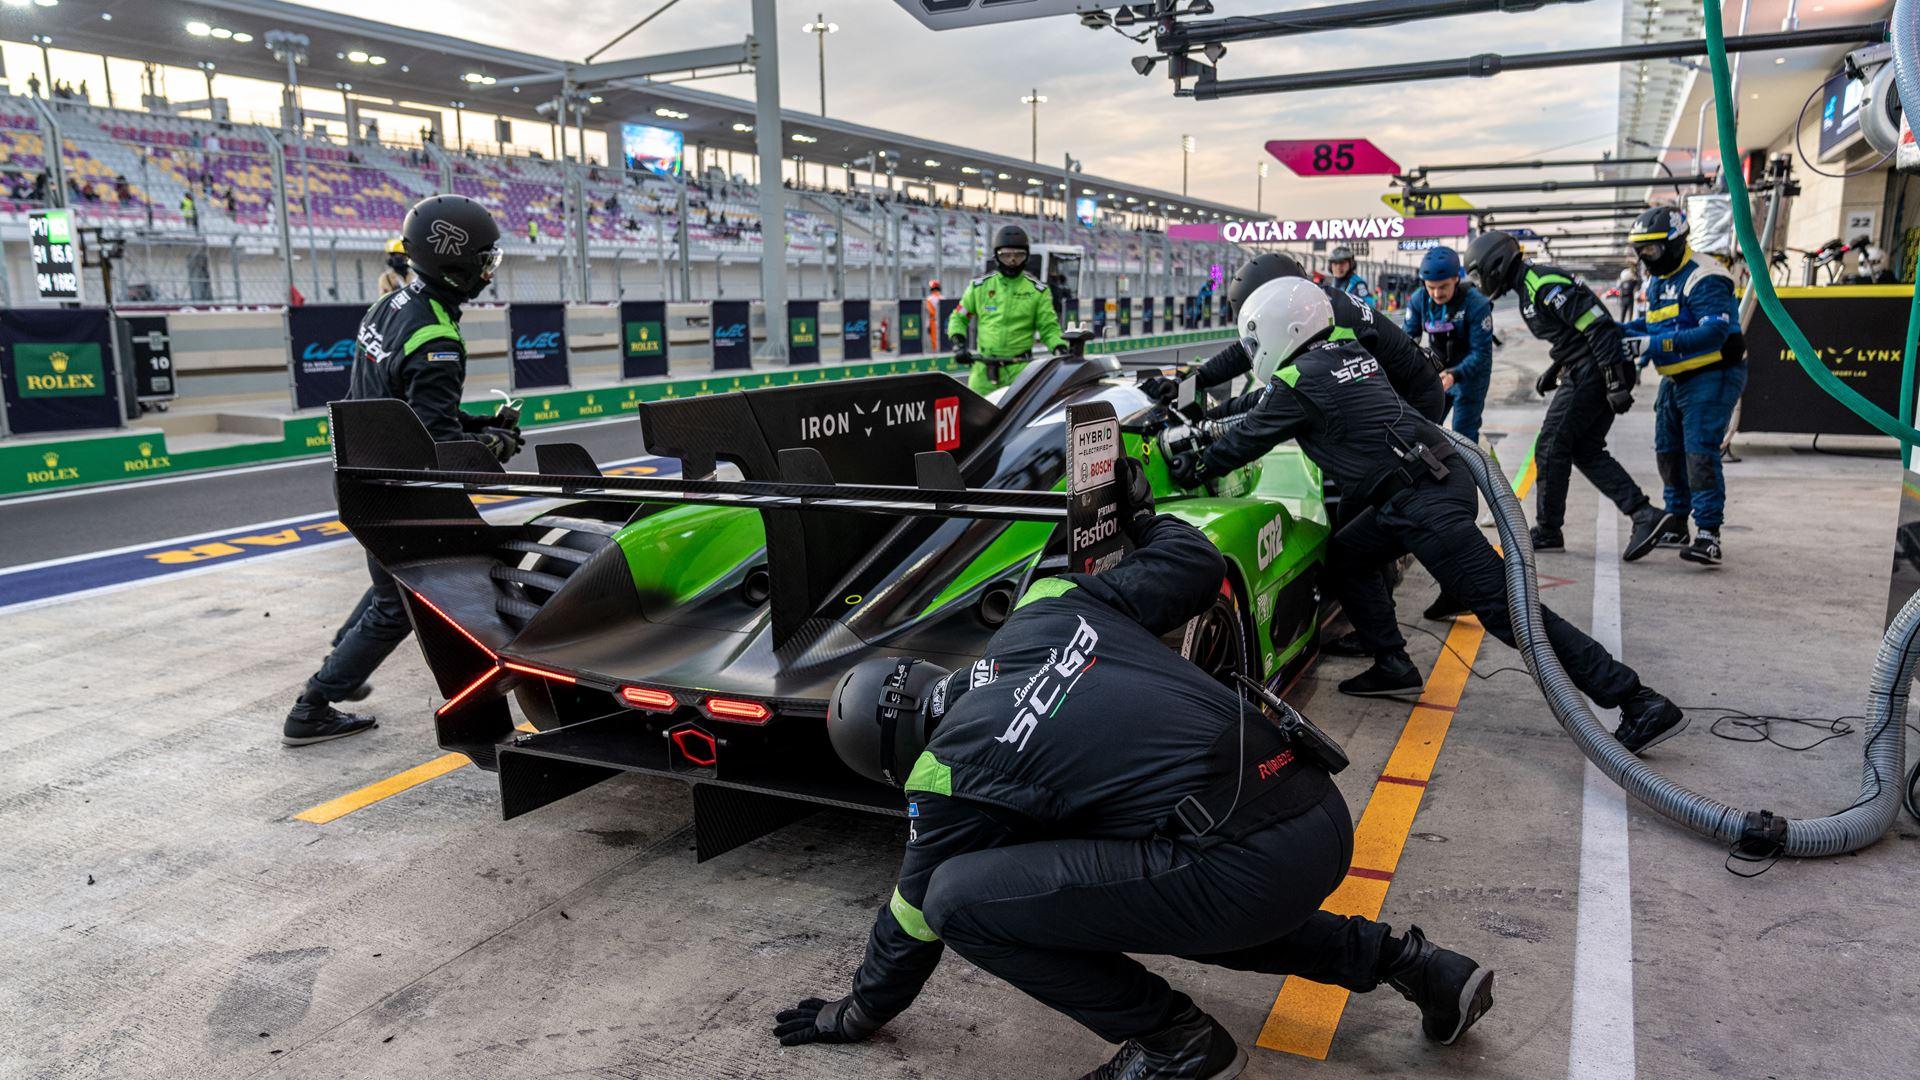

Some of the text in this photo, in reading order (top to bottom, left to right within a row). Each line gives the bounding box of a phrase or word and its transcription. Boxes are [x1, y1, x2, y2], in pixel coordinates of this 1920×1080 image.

[1313, 144, 1355, 172] 85
[1222, 217, 1404, 242] QATAR AIRWAYS
[151, 356, 170, 370] 10
[1780, 349, 1900, 362] IRN LYNX
[27, 374, 95, 390] ROLEX
[801, 401, 926, 440] IRON LYNX
[936, 406, 958, 443] HY
[1079, 425, 1112, 446] HYBRID
[124, 457, 171, 471] ROLEX
[1091, 459, 1112, 477] BOSCH
[27, 468, 79, 484] ROLEX
[995, 614, 1099, 752] SC63
